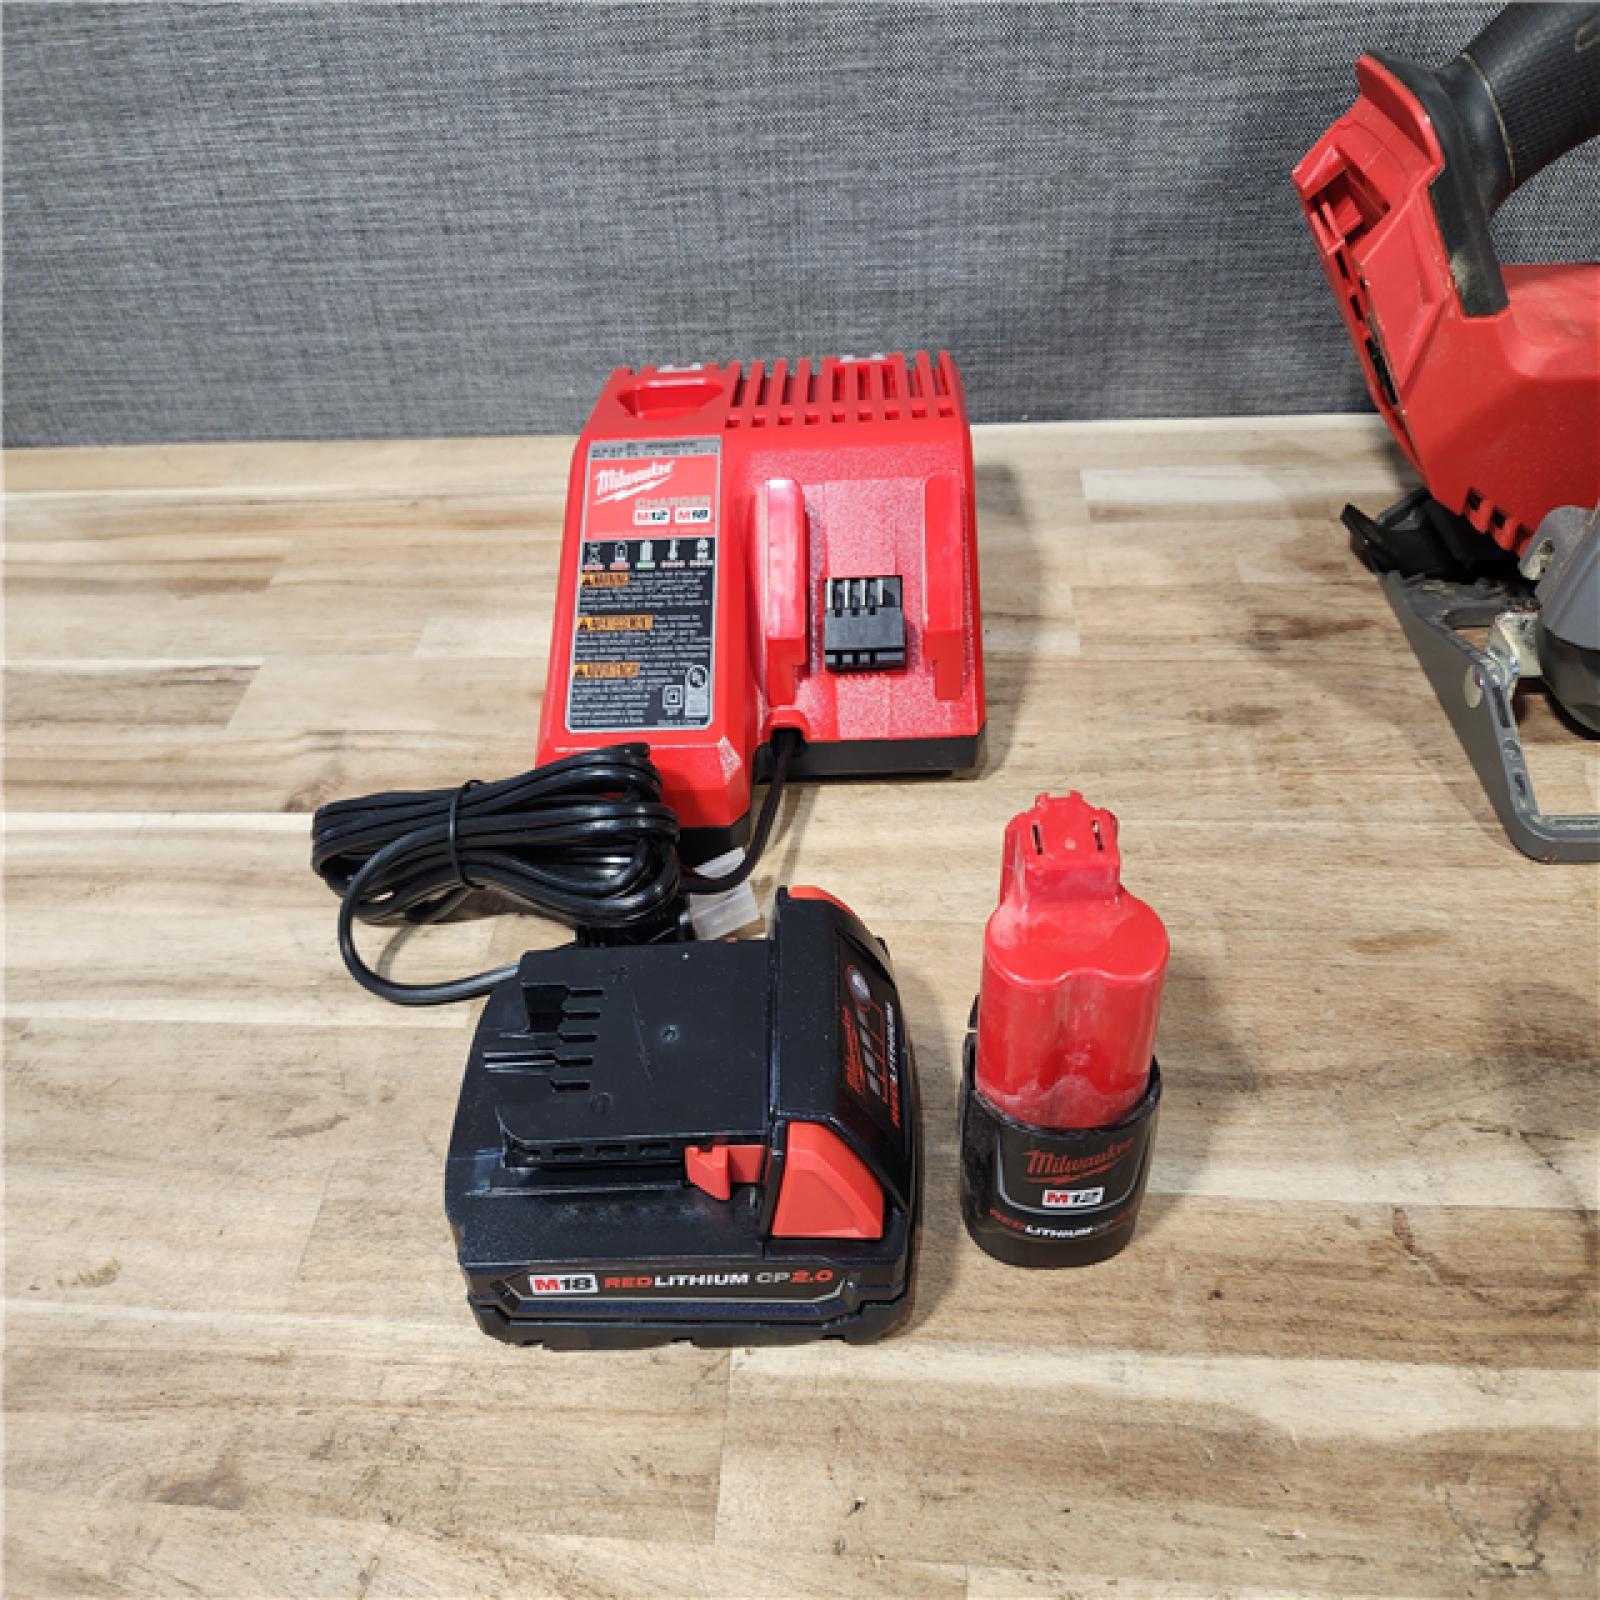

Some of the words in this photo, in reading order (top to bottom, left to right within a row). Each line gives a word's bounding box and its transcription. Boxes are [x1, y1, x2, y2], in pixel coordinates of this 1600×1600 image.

[594, 460, 675, 496] Milwaukee
[1024, 1137, 1136, 1175] Milwaukee
[1045, 1191, 1101, 1204] M12
[534, 1277, 594, 1292] M18
[604, 1273, 749, 1289] REDLITHIUM
[755, 1269, 834, 1285] CP2.0
